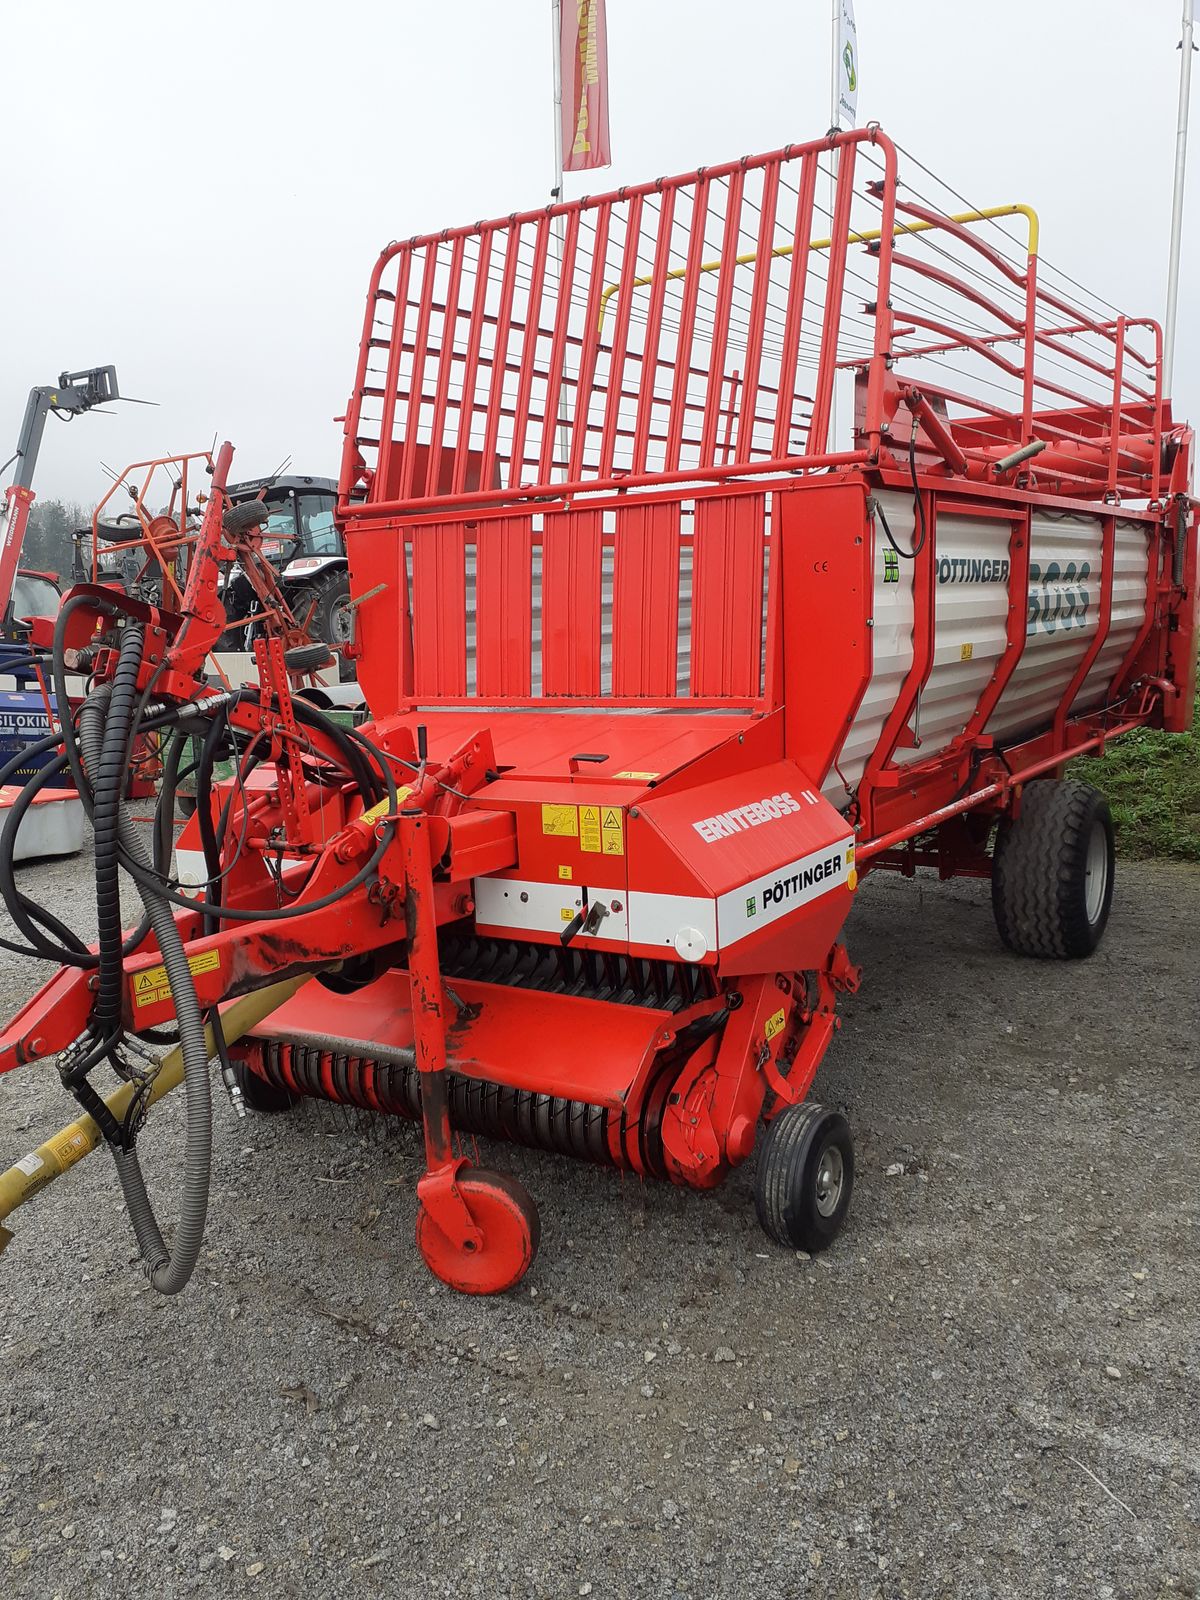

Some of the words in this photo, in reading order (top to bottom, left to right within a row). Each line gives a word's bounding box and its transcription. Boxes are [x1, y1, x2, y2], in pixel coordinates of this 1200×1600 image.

[692, 792, 801, 843] ERNTEBOSS
[801, 790, 819, 804] II
[762, 855, 841, 909] PÖTTINGER
